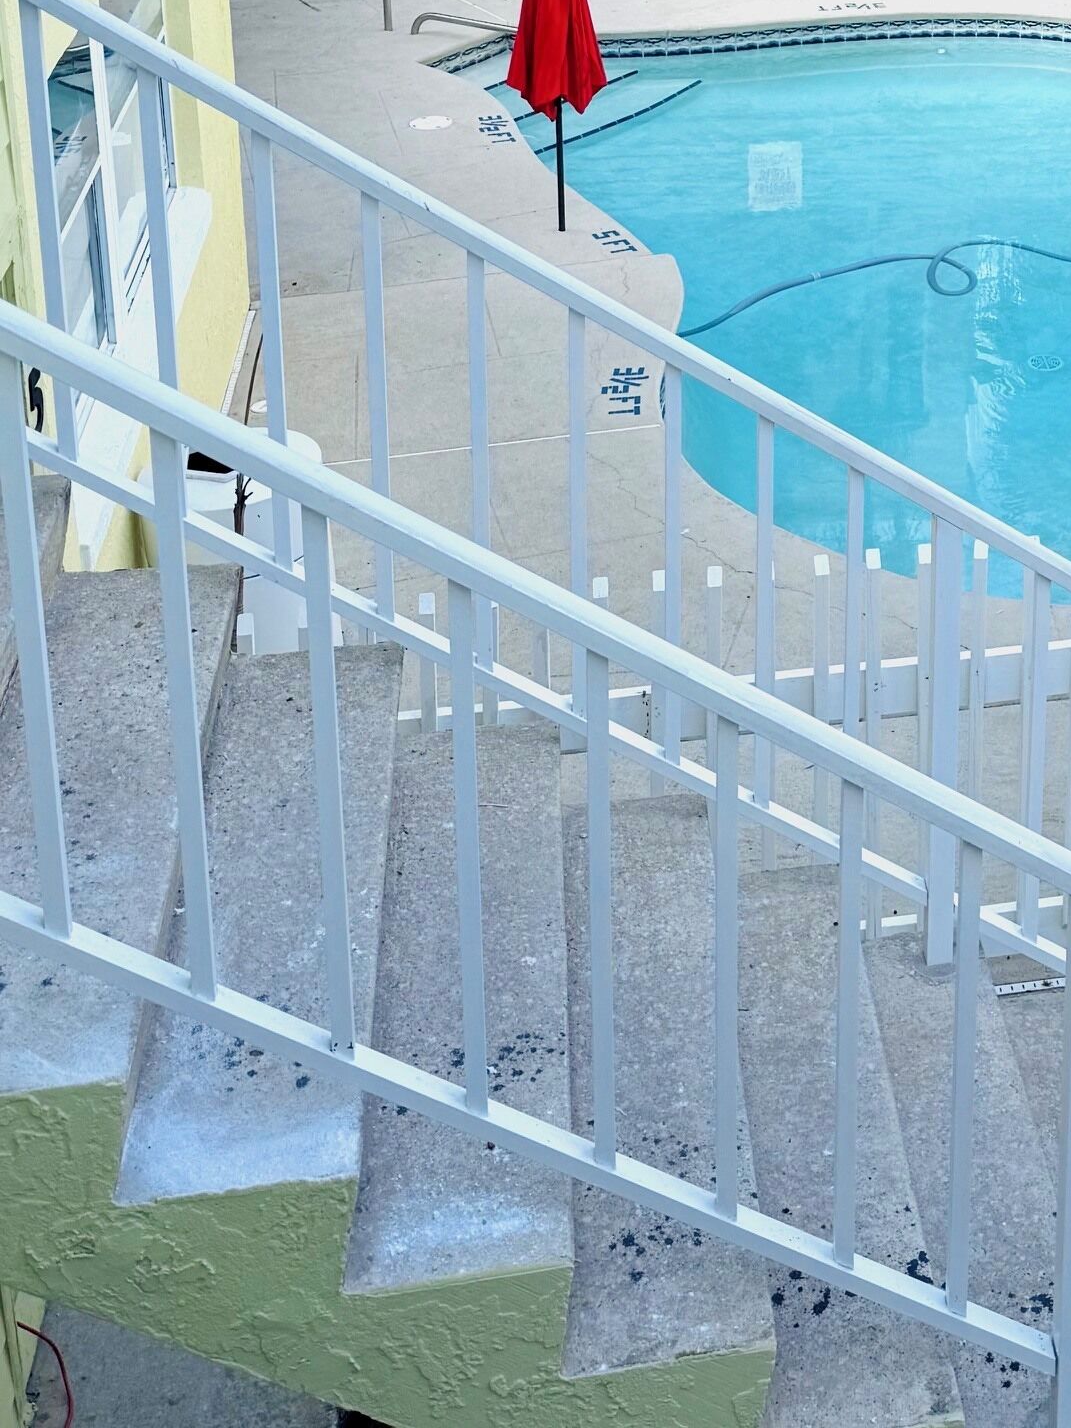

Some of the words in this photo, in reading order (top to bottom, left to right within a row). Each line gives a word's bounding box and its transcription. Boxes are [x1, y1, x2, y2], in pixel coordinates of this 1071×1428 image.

[592, 230, 621, 240] 5
[601, 239, 638, 254] FT
[608, 395, 642, 416] FT
